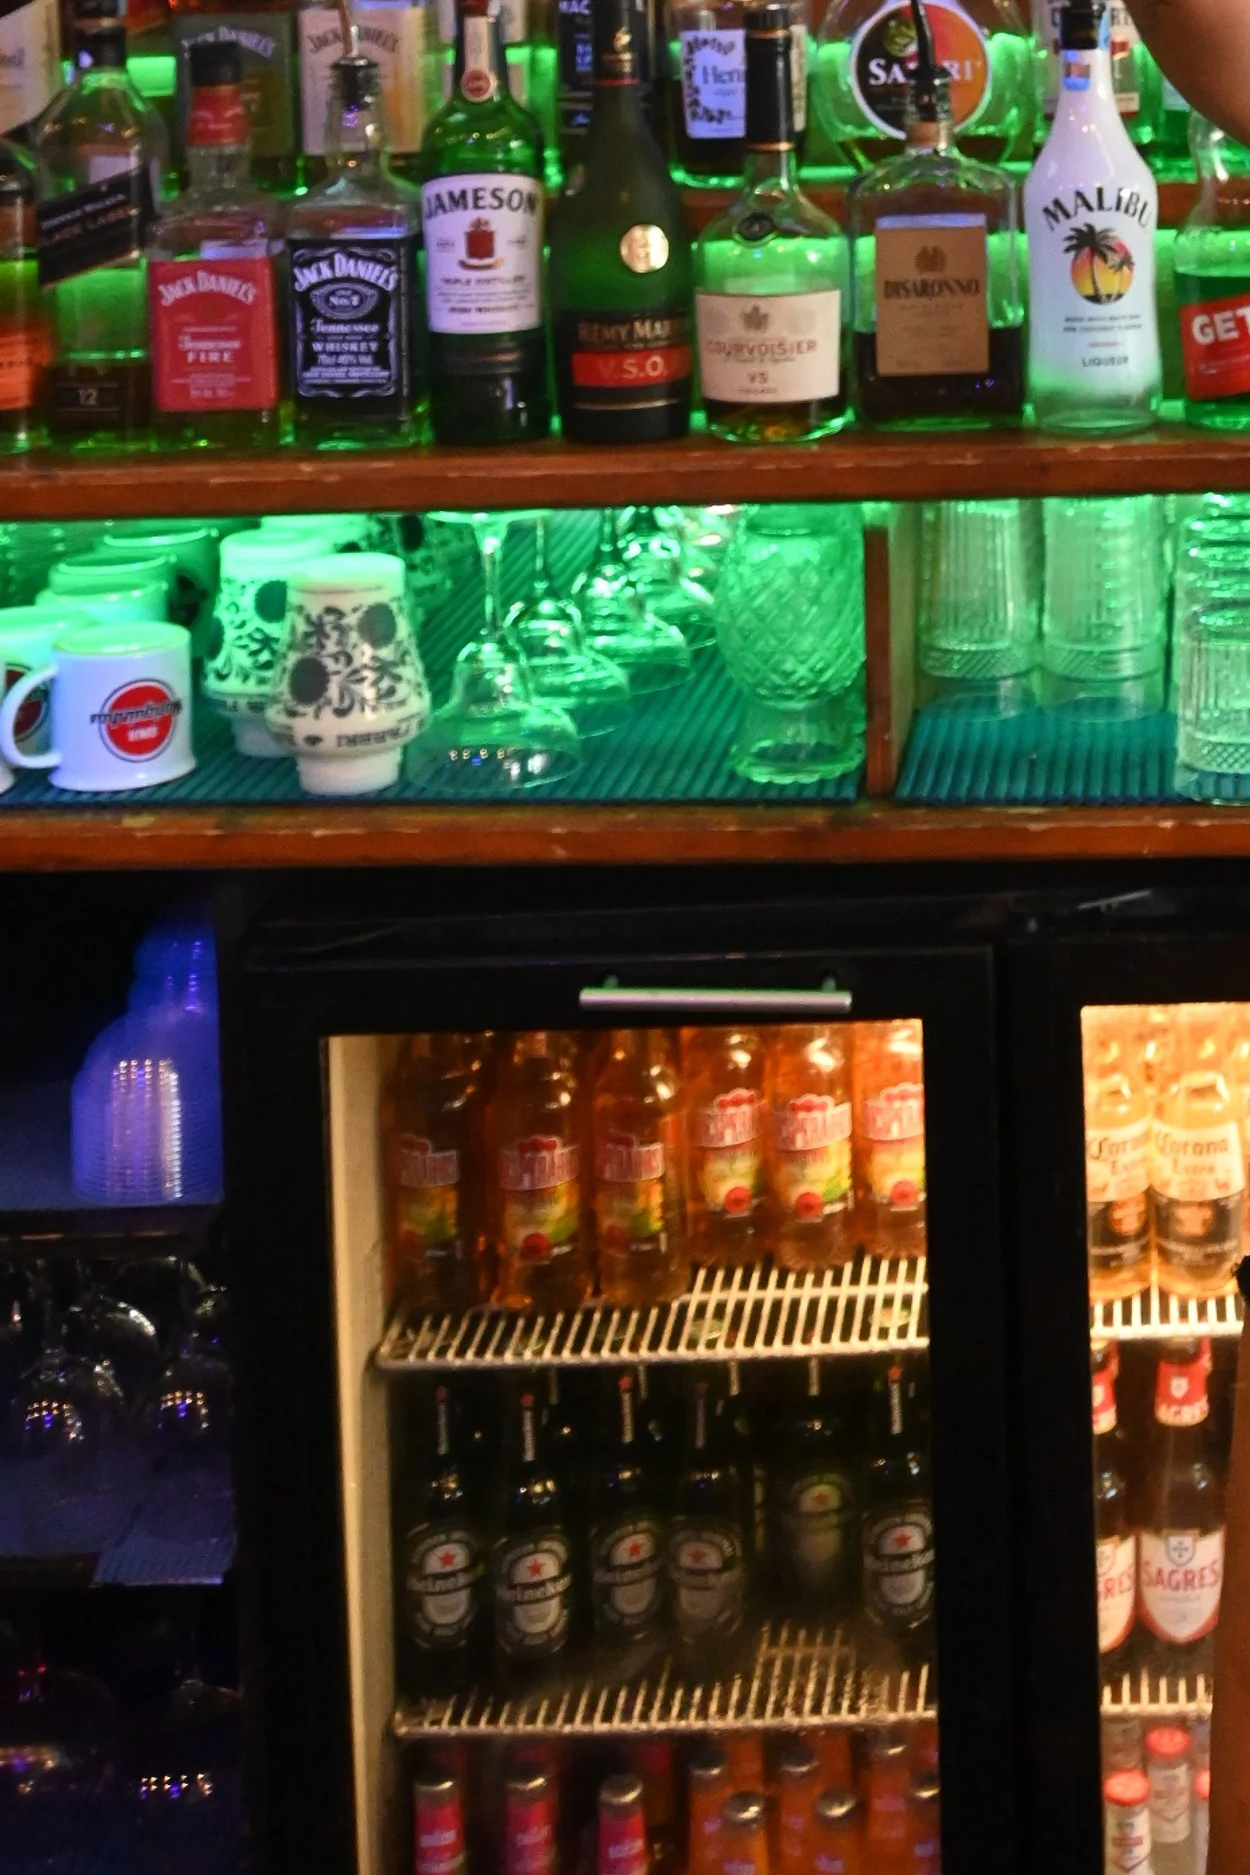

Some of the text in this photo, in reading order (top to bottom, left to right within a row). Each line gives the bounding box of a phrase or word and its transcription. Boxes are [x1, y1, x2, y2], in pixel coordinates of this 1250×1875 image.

[868, 58, 972, 86] SARI
[424, 187, 537, 220] JAMESON
[1043, 187, 1152, 233] MALIBU
[293, 252, 399, 292] JACK DANIEL'S
[187, 350, 231, 364] FIRE
[311, 341, 379, 353] WHISKEY
[77, 388, 98, 406] 12
[1155, 1130, 1229, 1158] Corona
[1140, 1561, 1219, 1592] SAGRES
